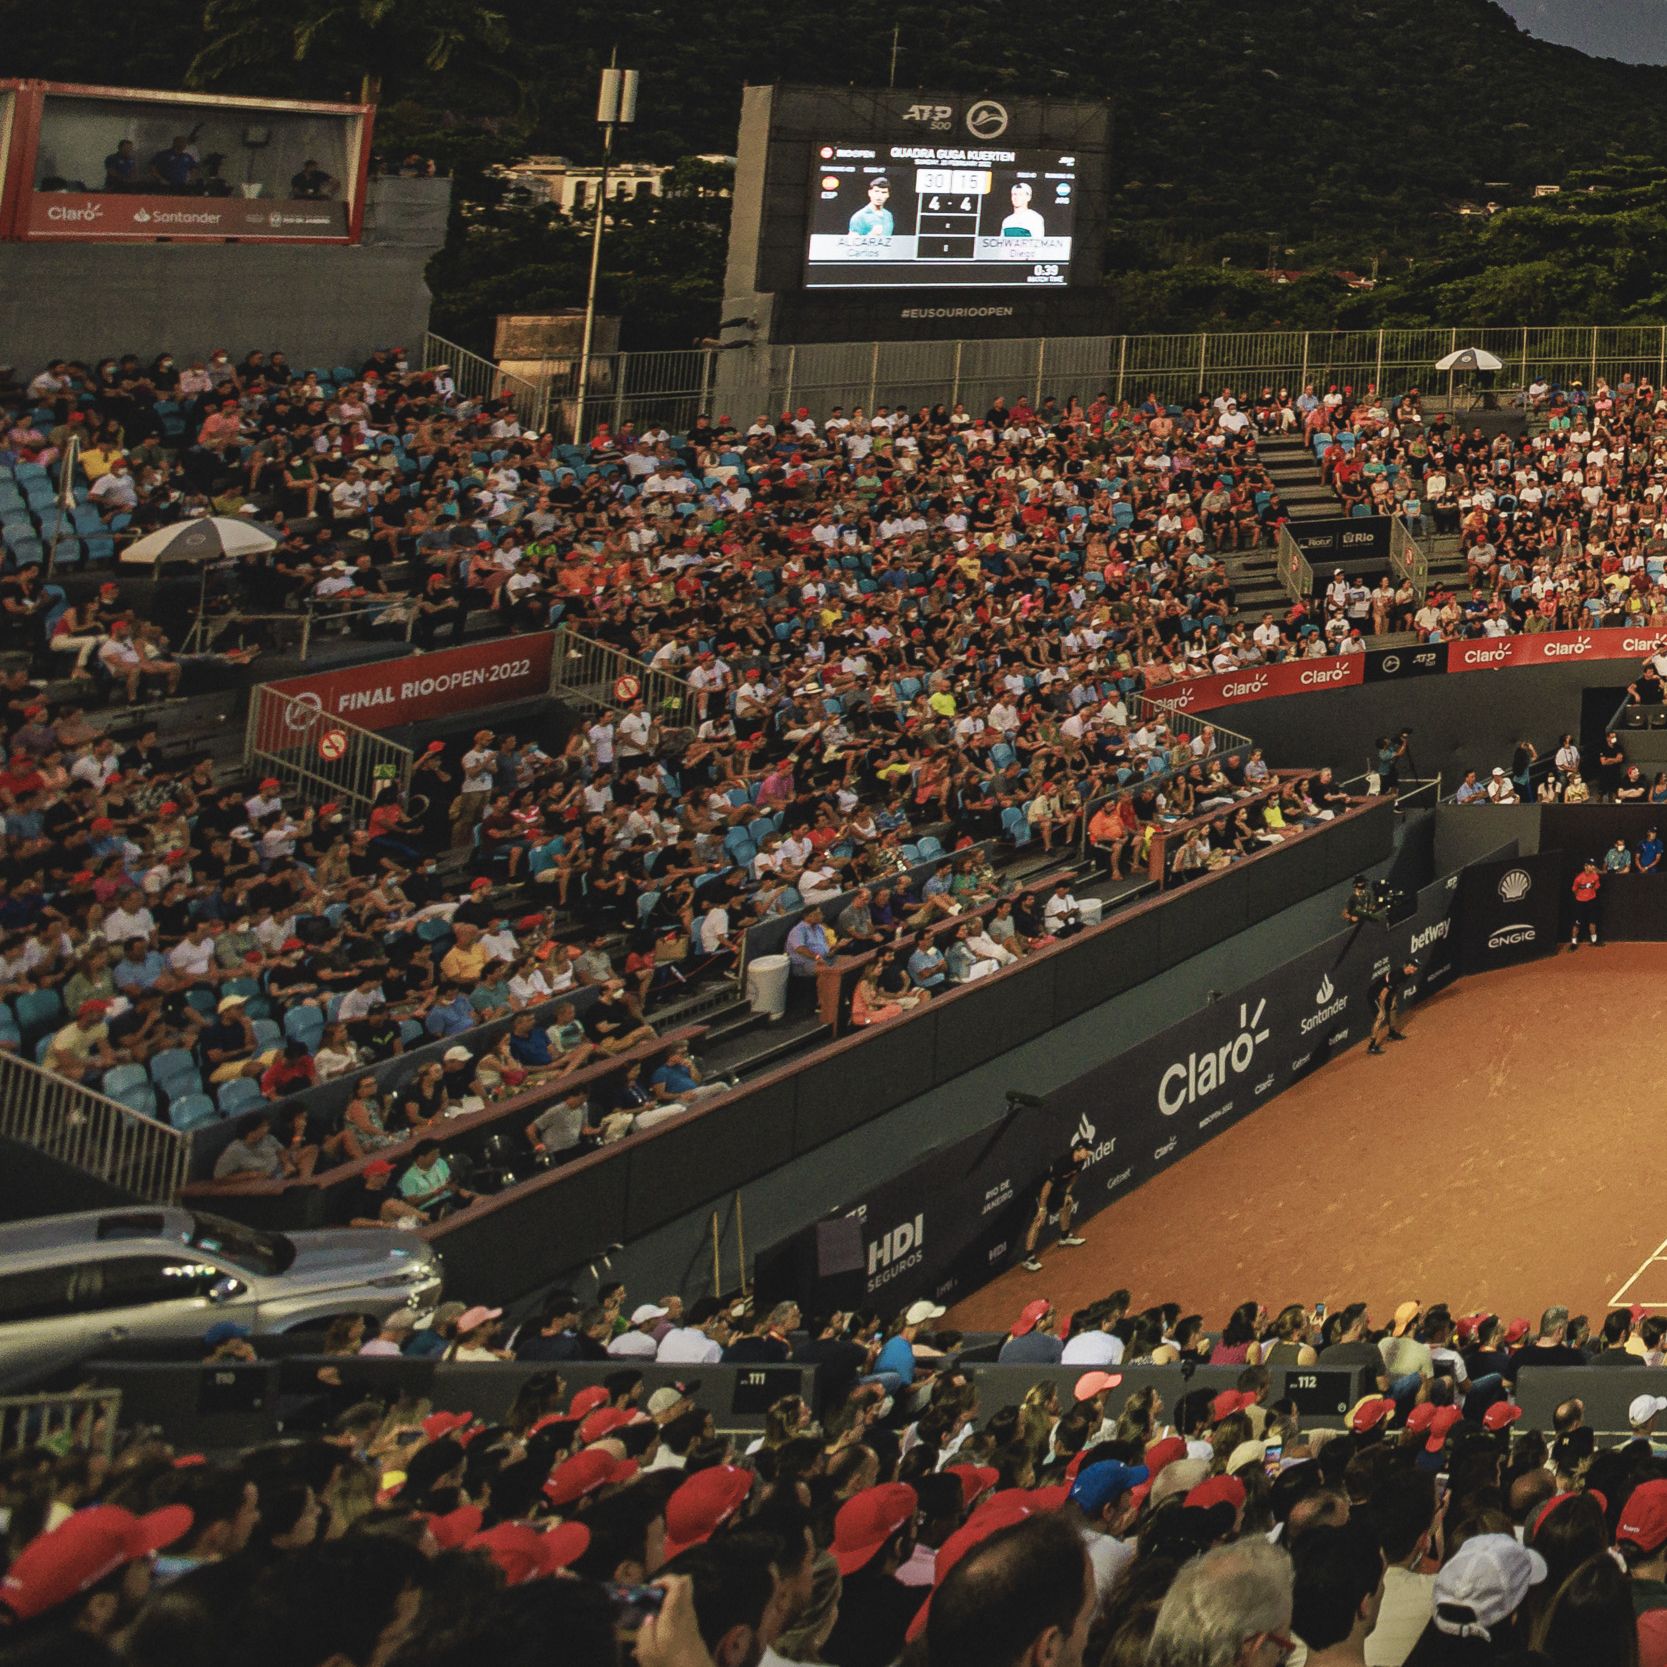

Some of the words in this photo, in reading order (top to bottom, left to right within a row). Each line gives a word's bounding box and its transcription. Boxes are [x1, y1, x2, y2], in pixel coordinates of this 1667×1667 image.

[902, 105, 953, 121] ATP
[890, 147, 936, 160] QUADRA
[936, 149, 965, 161] GUGA
[967, 150, 1016, 162] KUERTEN
[924, 173, 944, 188] 30
[960, 174, 979, 189] 15
[929, 196, 940, 211] 4
[960, 197, 971, 211] 4
[48, 205, 95, 222] Claro
[153, 210, 222, 225] Santander
[837, 236, 892, 248] ALCARAZ
[982, 238, 1063, 249] SCHWARTZMAN
[847, 248, 879, 258] Carlos
[1009, 249, 1036, 259] Diego
[901, 307, 1013, 318] #EUSOURIOOPEN
[1354, 533, 1375, 543] Rio
[1544, 641, 1585, 657] Claro
[1623, 637, 1664, 652] Claro
[1464, 648, 1506, 665] Claro
[1300, 666, 1344, 686] Claro
[1222, 677, 1262, 699] Claro
[339, 686, 396, 713] FINAL
[1410, 917, 1452, 954] betway
[1301, 995, 1348, 1035] Santander
[1329, 1028, 1349, 1046] betway
[1158, 1032, 1254, 1116] Claro
[1255, 1078, 1273, 1095] Claro
[1154, 1141, 1175, 1160] Claro
[985, 1186, 999, 1201] RIO
[1000, 1179, 1011, 1191] DE
[981, 1189, 1014, 1216] JANEIRO
[867, 1213, 925, 1277] HDI
[988, 1242, 1007, 1263] HDI
[867, 1250, 924, 1294] SEGUROS
[749, 1373, 765, 1385] 111
[1298, 1376, 1317, 1388] 112
